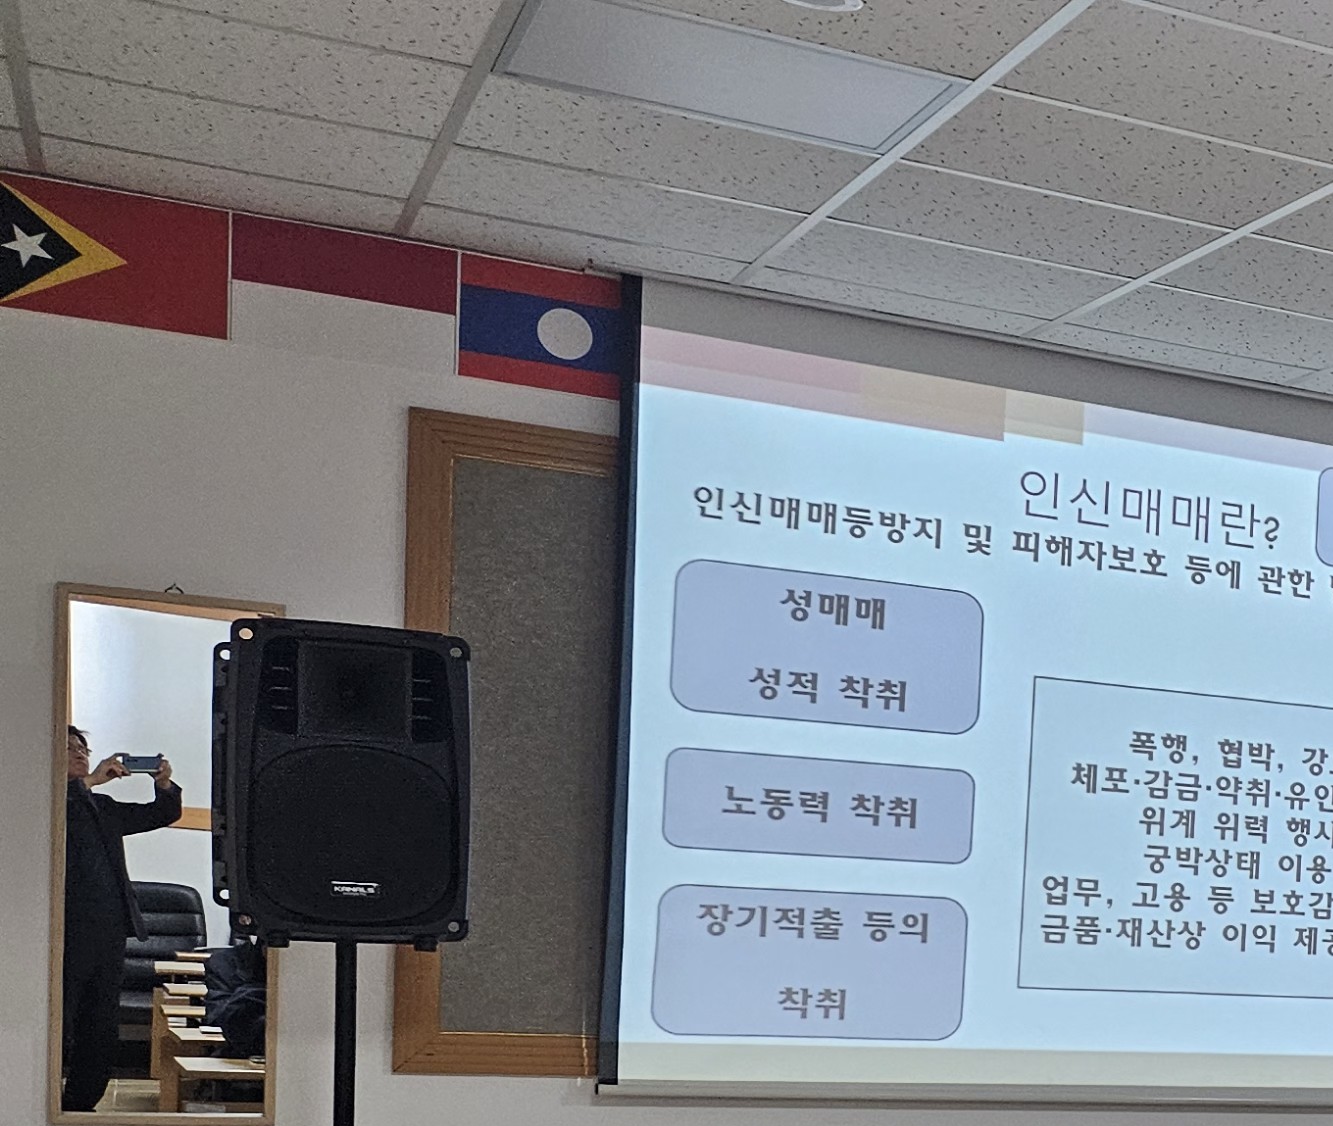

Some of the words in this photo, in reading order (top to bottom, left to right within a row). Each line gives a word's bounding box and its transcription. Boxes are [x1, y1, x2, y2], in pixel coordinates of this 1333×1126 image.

[1019, 470, 1281, 550] 인신매매란?
[693, 486, 942, 549] 인신매매등방지
[963, 523, 992, 556] 및
[1012, 530, 1168, 578] 피해자보호
[1185, 554, 1242, 589] 등에
[1257, 565, 1315, 599] 관한
[780, 589, 886, 630] 성매매
[749, 667, 819, 704] 성적
[839, 675, 907, 712] 착취
[1128, 730, 1199, 765] 폭행,
[1217, 738, 1284, 771] 협박,
[721, 785, 830, 823] 노동력
[850, 794, 918, 829] 착취
[1138, 806, 1196, 839] 위계
[1213, 812, 1269, 844] 위력
[1143, 844, 1261, 880] 궁박상태
[1278, 853, 1333, 884] 이용
[1042, 875, 1113, 908] 업무,
[1131, 881, 1191, 913] 고용
[1207, 886, 1235, 915] 등
[696, 903, 844, 941] 장기적출
[862, 911, 929, 943] 등의
[1040, 913, 1206, 951] 금품·재산상
[1222, 923, 1276, 953] 이익
[778, 987, 848, 1020] 착취
